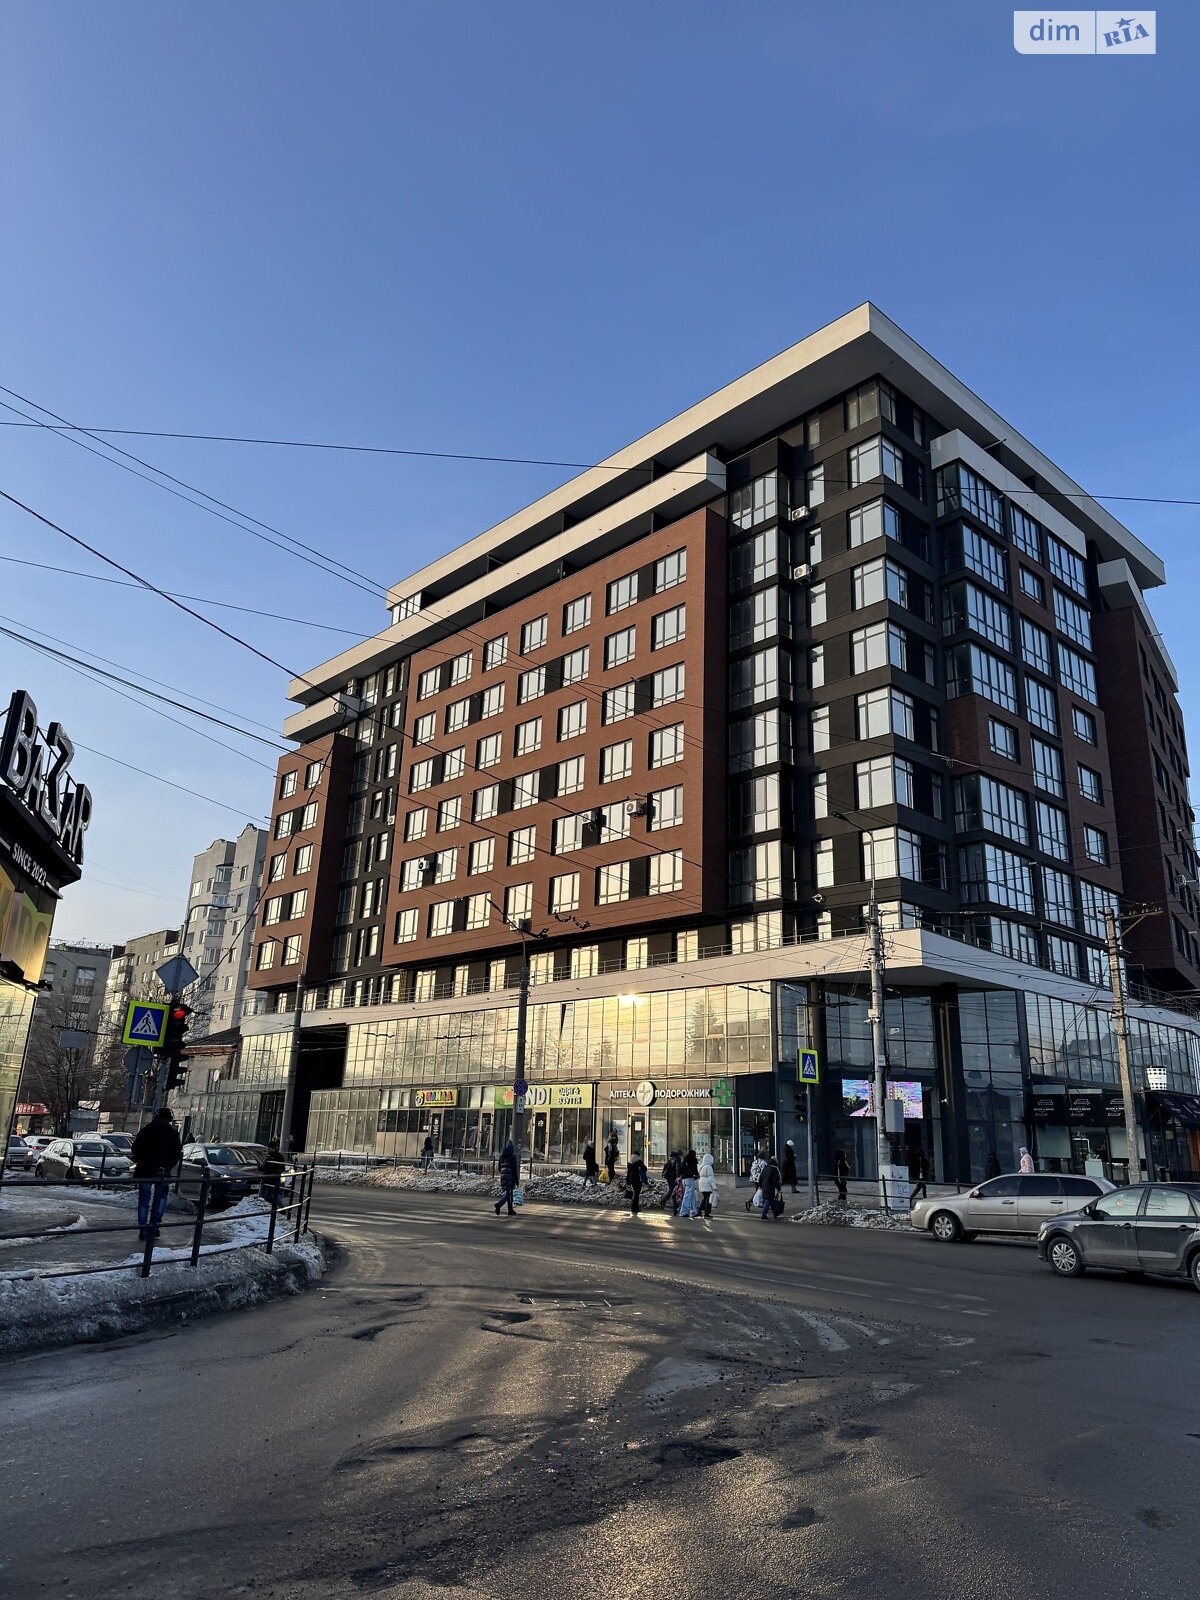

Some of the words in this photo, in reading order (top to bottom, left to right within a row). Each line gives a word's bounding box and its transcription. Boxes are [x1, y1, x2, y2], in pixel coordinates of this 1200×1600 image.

[12, 842, 32, 873] SINCE
[31, 861, 47, 887] 2022
[525, 1087, 552, 1105] NDI
[610, 1090, 636, 1099] АПТЕКА
[655, 1089, 711, 1099] ПОДОРОЖНИК
